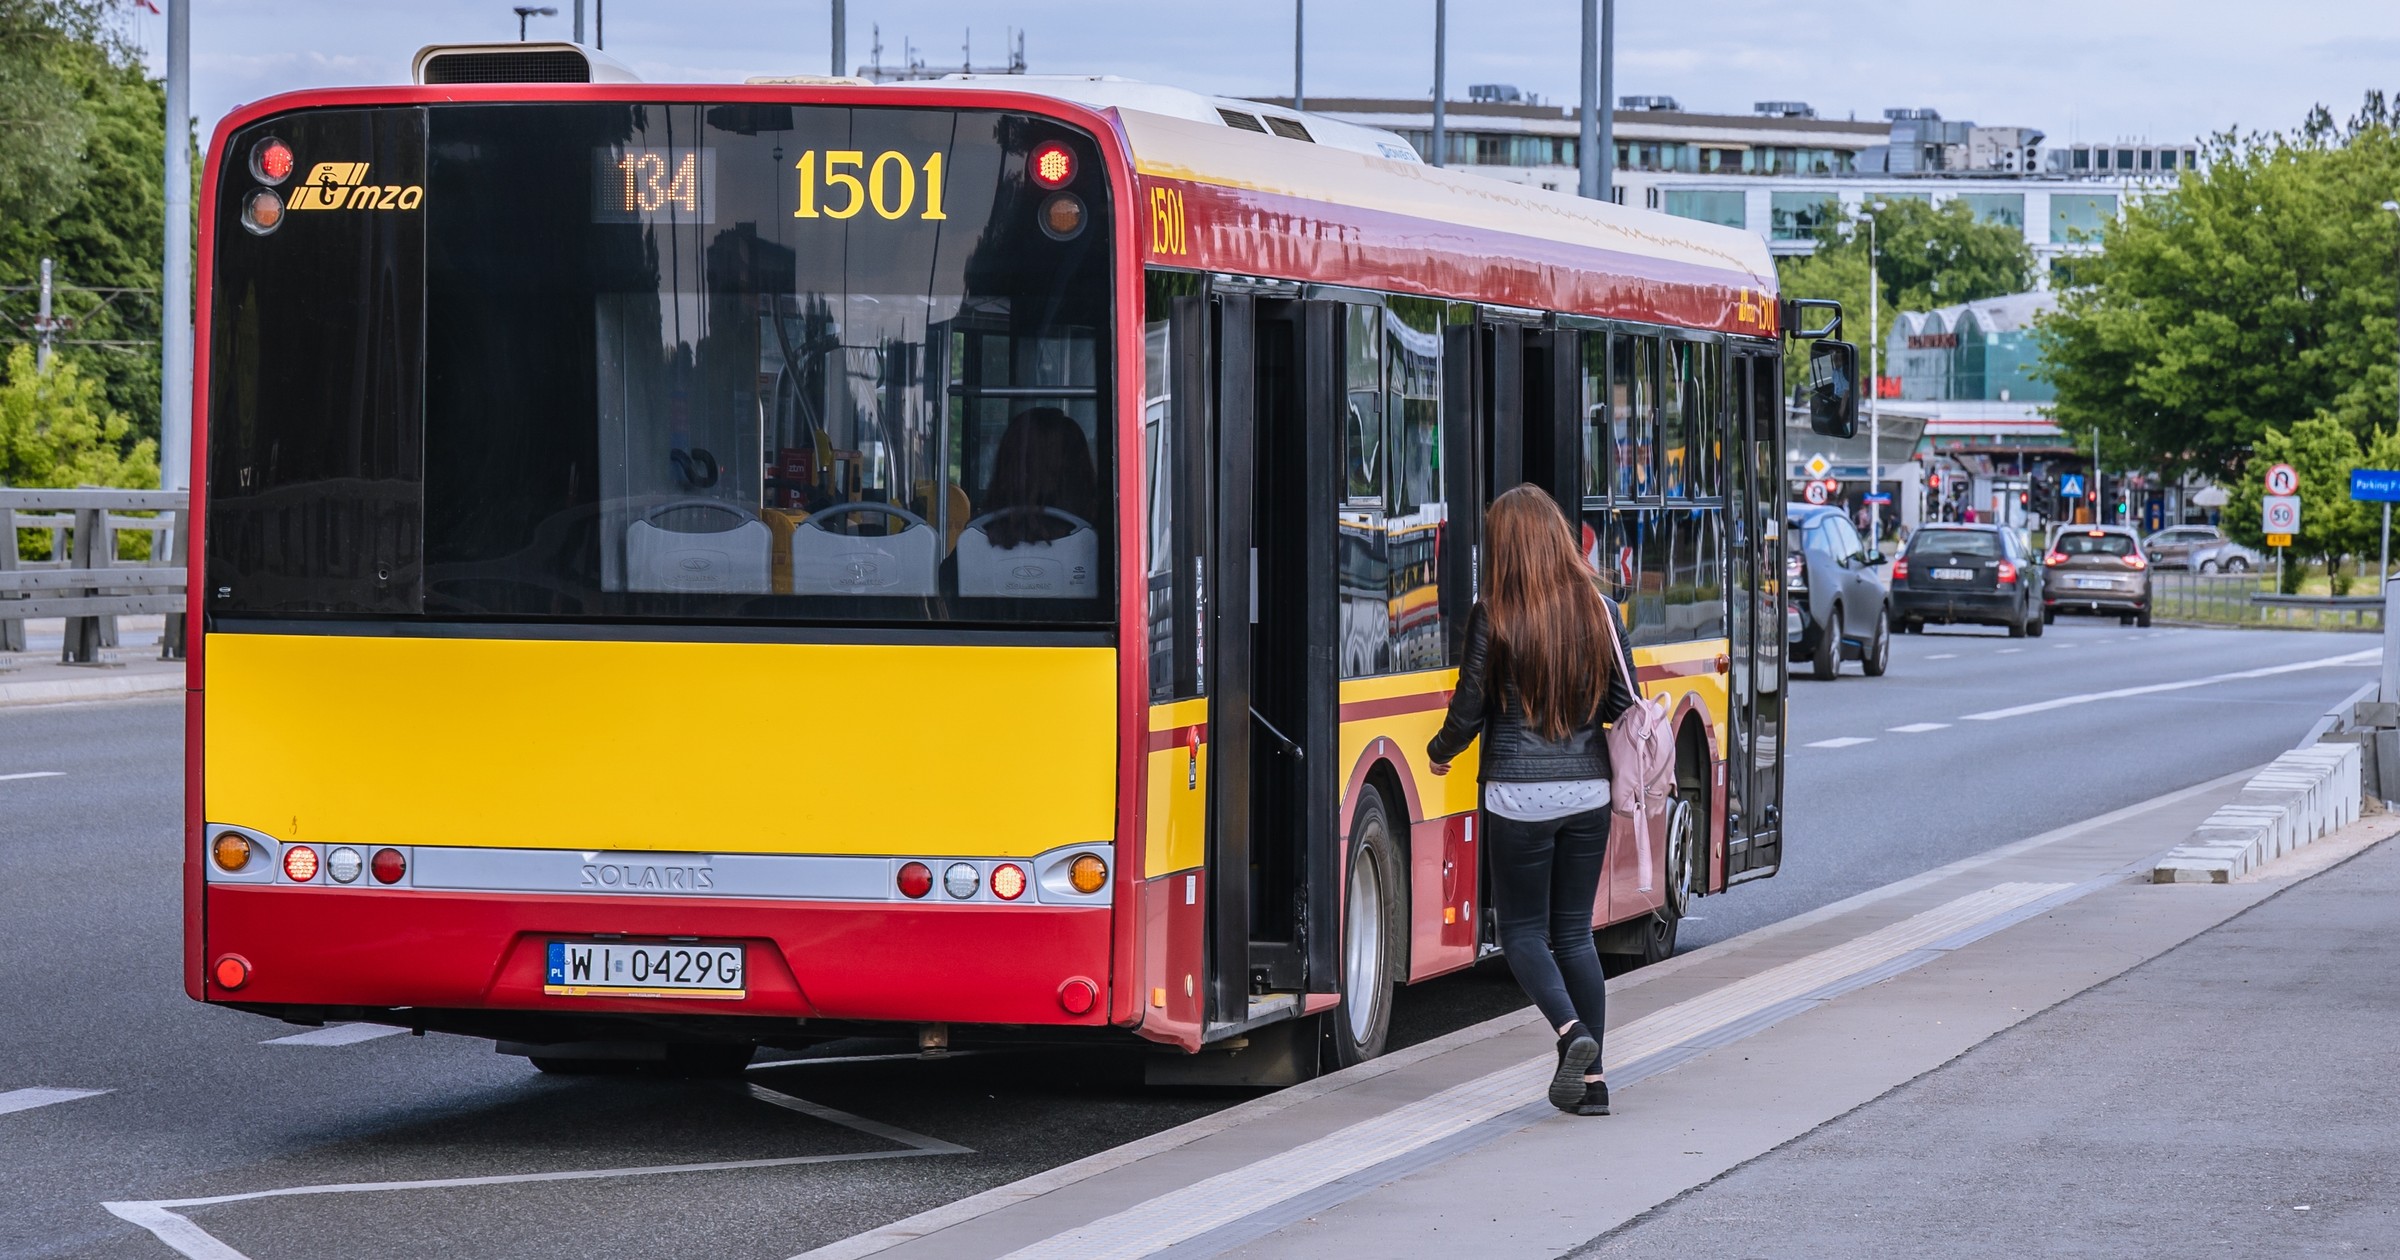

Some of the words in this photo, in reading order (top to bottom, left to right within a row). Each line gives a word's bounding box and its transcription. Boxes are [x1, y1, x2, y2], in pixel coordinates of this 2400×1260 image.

[617, 153, 695, 212] 134
[794, 150, 947, 220] 1501
[346, 185, 424, 210] mza
[1150, 186, 1187, 255] 1501
[2356, 479, 2389, 493] Parking
[2273, 509, 2290, 522] 50
[581, 864, 715, 891] SOLARIS
[551, 968, 563, 978] PL
[632, 950, 737, 984] 0429G
